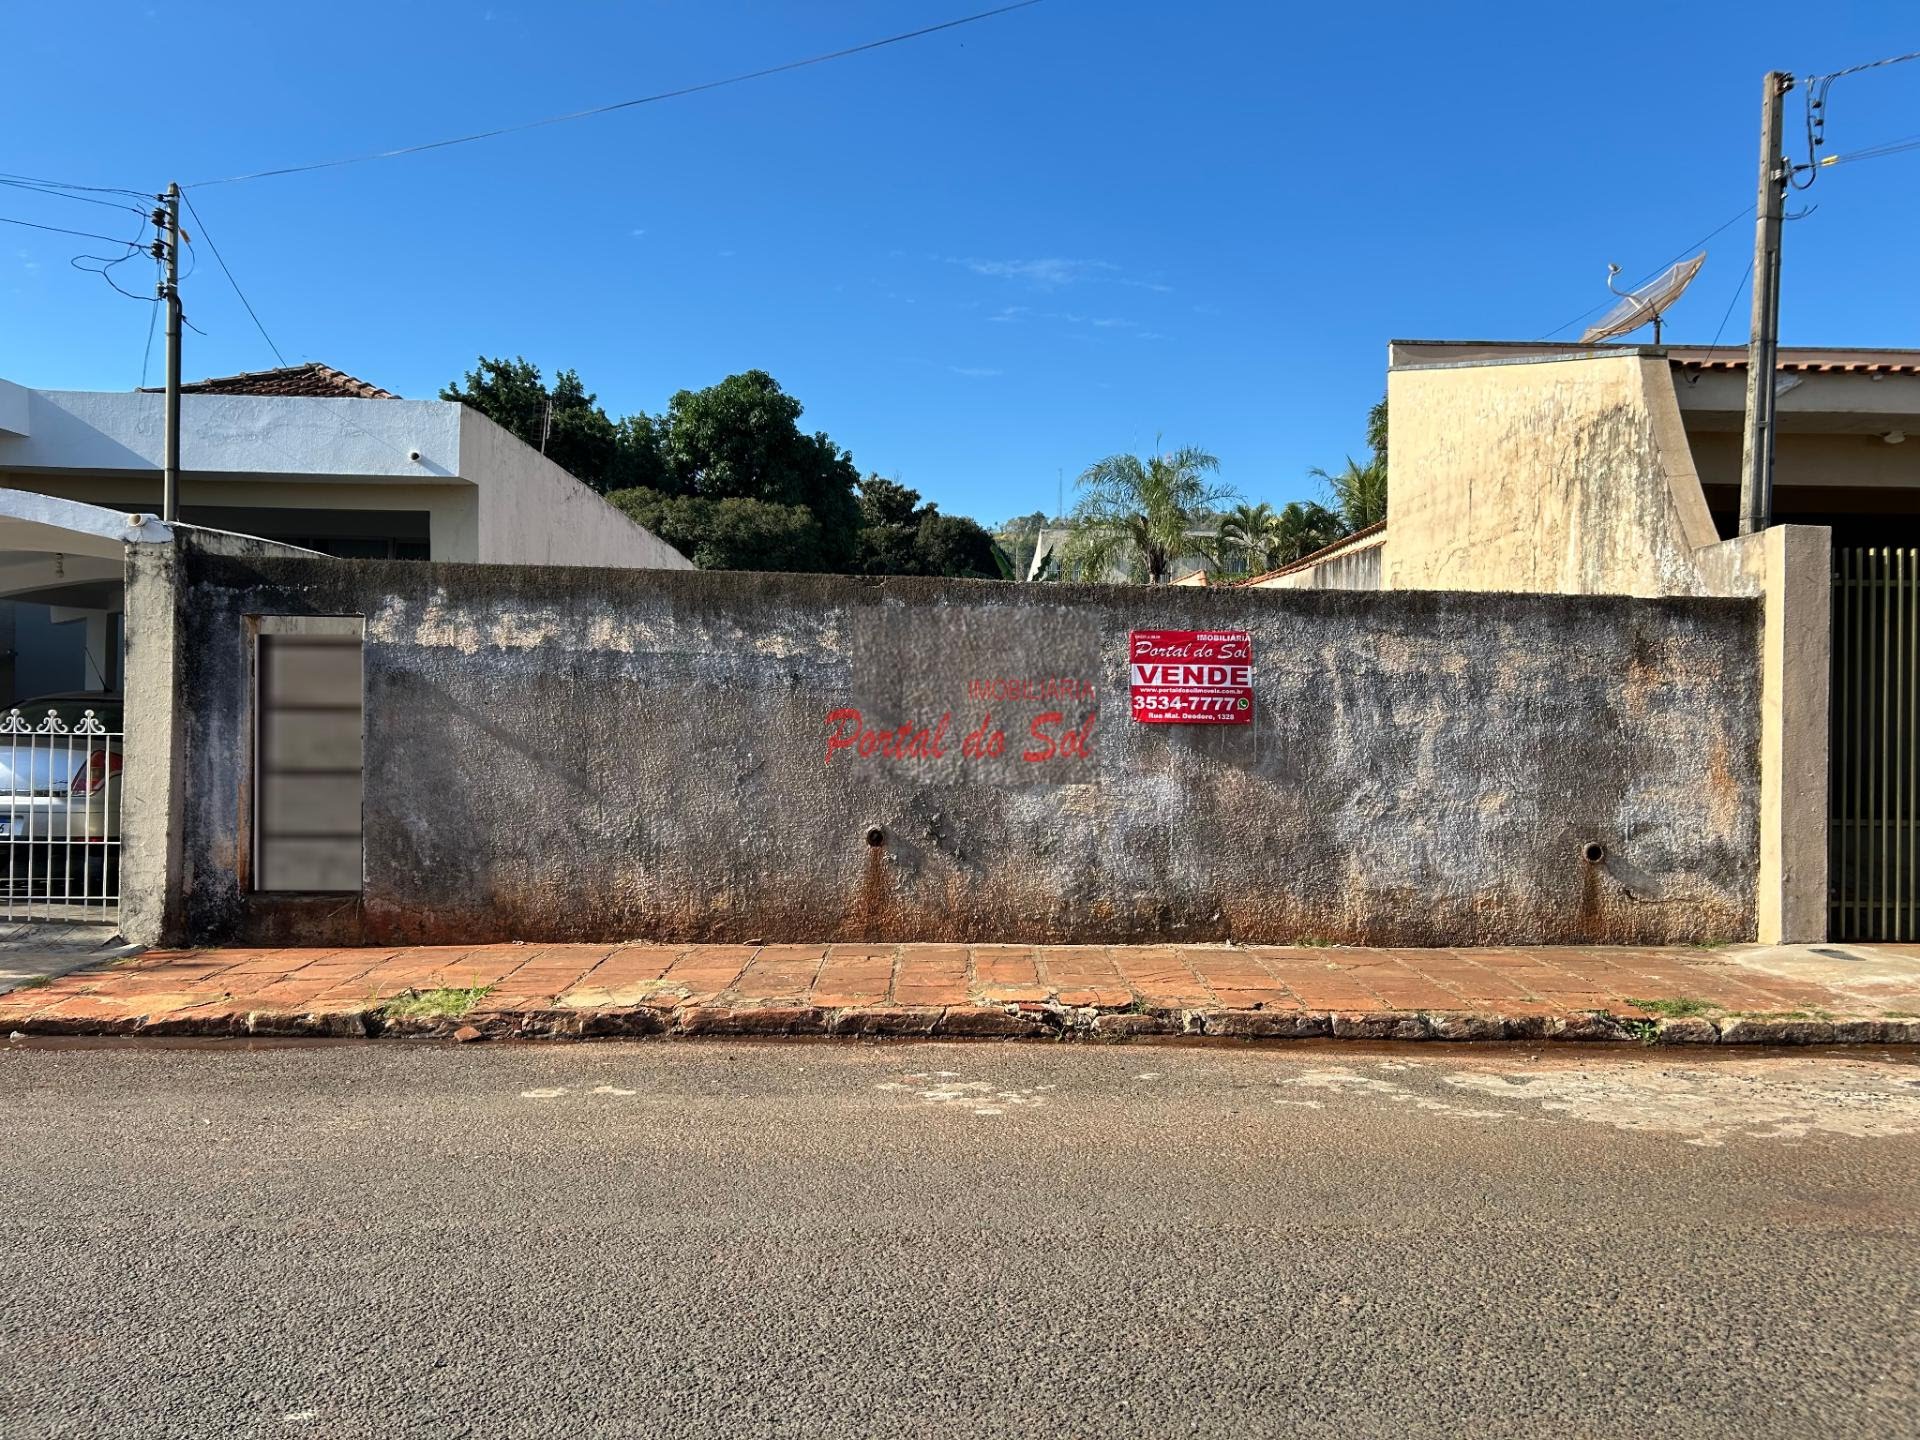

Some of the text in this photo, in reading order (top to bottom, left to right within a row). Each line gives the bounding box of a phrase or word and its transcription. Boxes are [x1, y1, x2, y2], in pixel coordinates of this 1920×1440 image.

[1135, 641, 1250, 659] Portal do Sol
[1136, 666, 1249, 685] VENDE
[1133, 695, 1236, 711] 3534-7777
